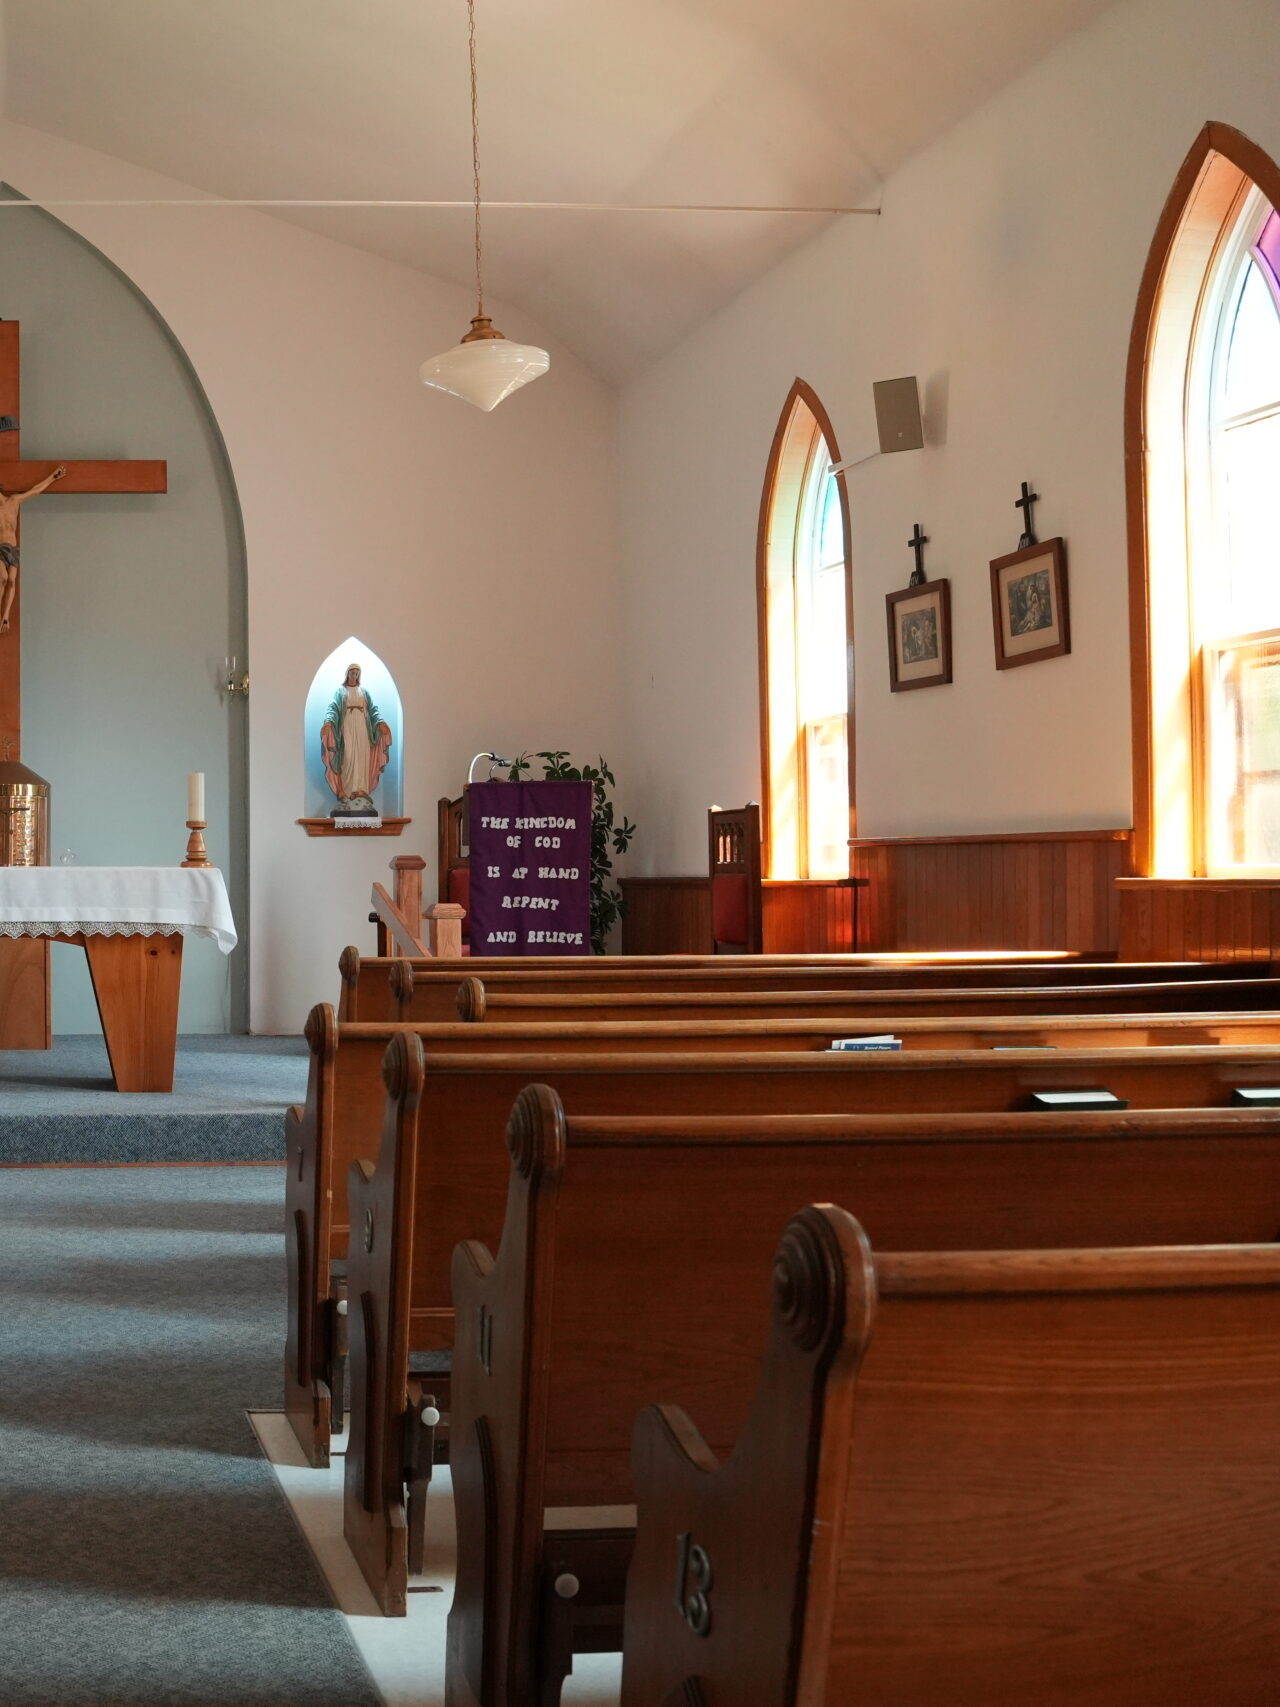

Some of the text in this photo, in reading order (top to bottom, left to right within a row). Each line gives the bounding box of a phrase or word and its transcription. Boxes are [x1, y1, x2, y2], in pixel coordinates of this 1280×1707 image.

[481, 816, 576, 829] THE KINGDOM
[506, 835, 560, 849] OF GOD
[487, 866, 579, 880] IS AT HAND
[502, 896, 560, 911] REPENT
[486, 930, 583, 945] AND BELIEVE
